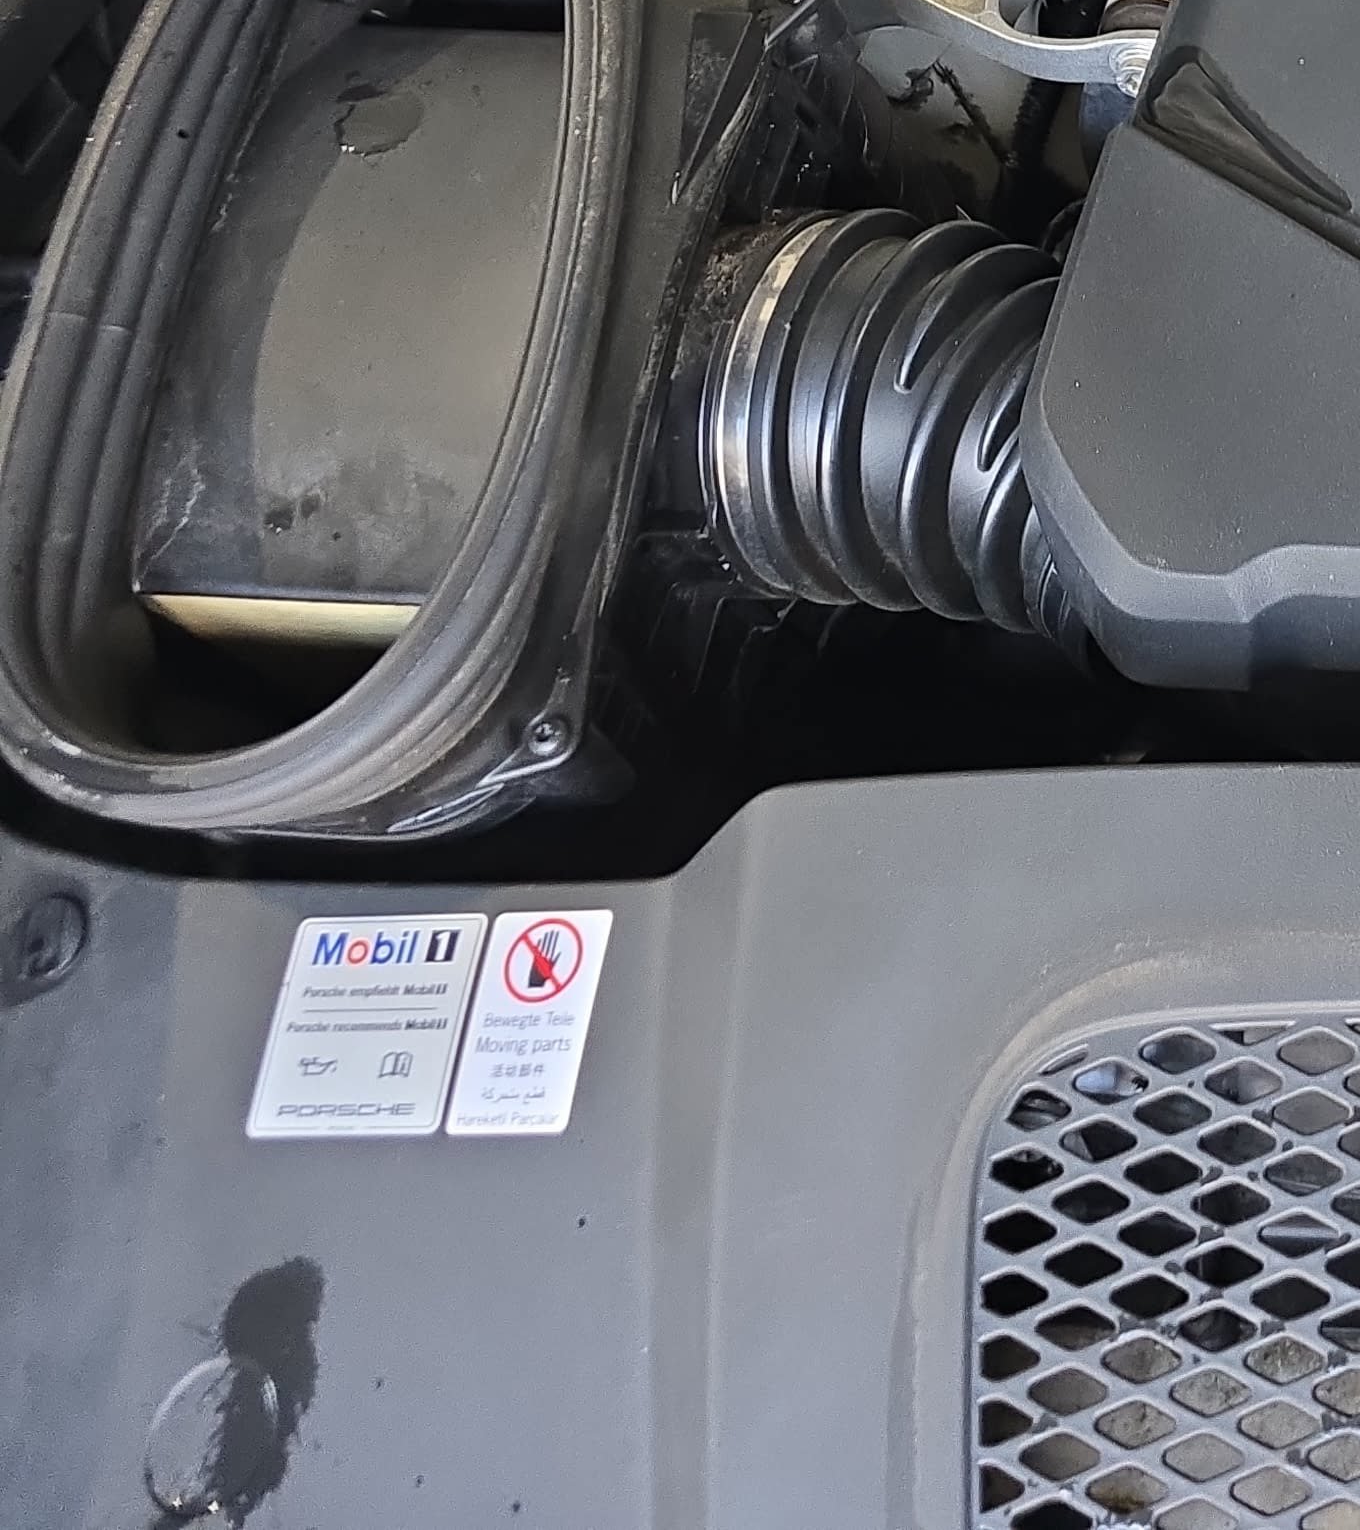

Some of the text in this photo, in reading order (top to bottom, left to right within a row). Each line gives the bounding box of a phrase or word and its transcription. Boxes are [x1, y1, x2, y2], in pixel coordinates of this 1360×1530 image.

[311, 929, 421, 966] Mobil
[303, 986, 346, 998] Porsche
[286, 1021, 329, 1033] Porsche
[332, 1020, 402, 1032] recommends
[482, 1011, 576, 1030] Bewegte Teile
[474, 1036, 573, 1056] Moving parts
[276, 1102, 417, 1117] PORSCHE
